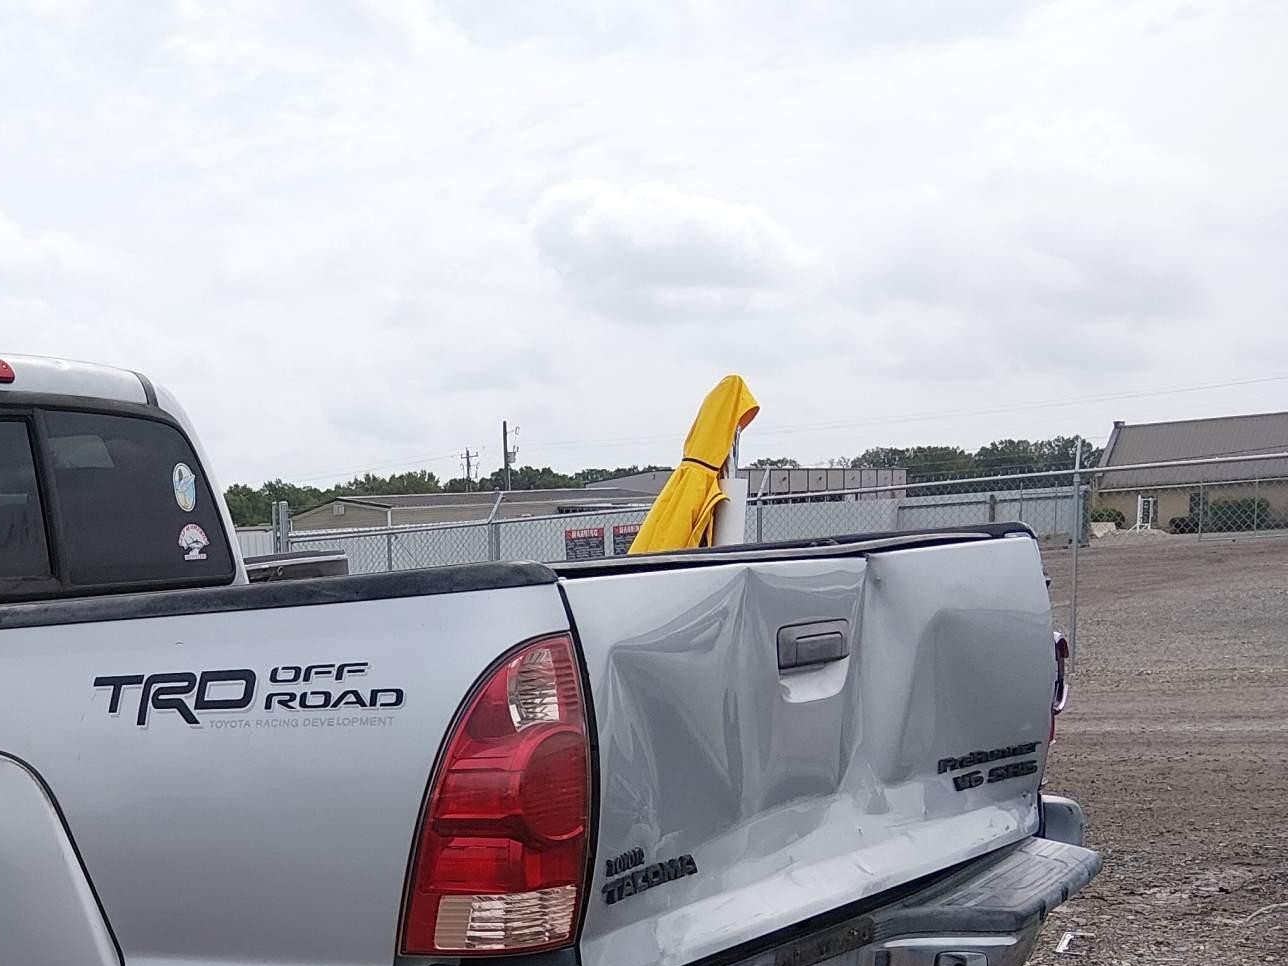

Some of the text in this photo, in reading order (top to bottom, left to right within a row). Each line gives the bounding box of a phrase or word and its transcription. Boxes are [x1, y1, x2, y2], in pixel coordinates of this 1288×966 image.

[572, 528, 599, 539] WARNING
[269, 661, 369, 684] OFF
[93, 668, 257, 726] TRD
[264, 688, 404, 710] ROAD
[210, 716, 395, 729] TOYOTA RACING DEVELOPMENT
[601, 854, 698, 905] TACOMA
